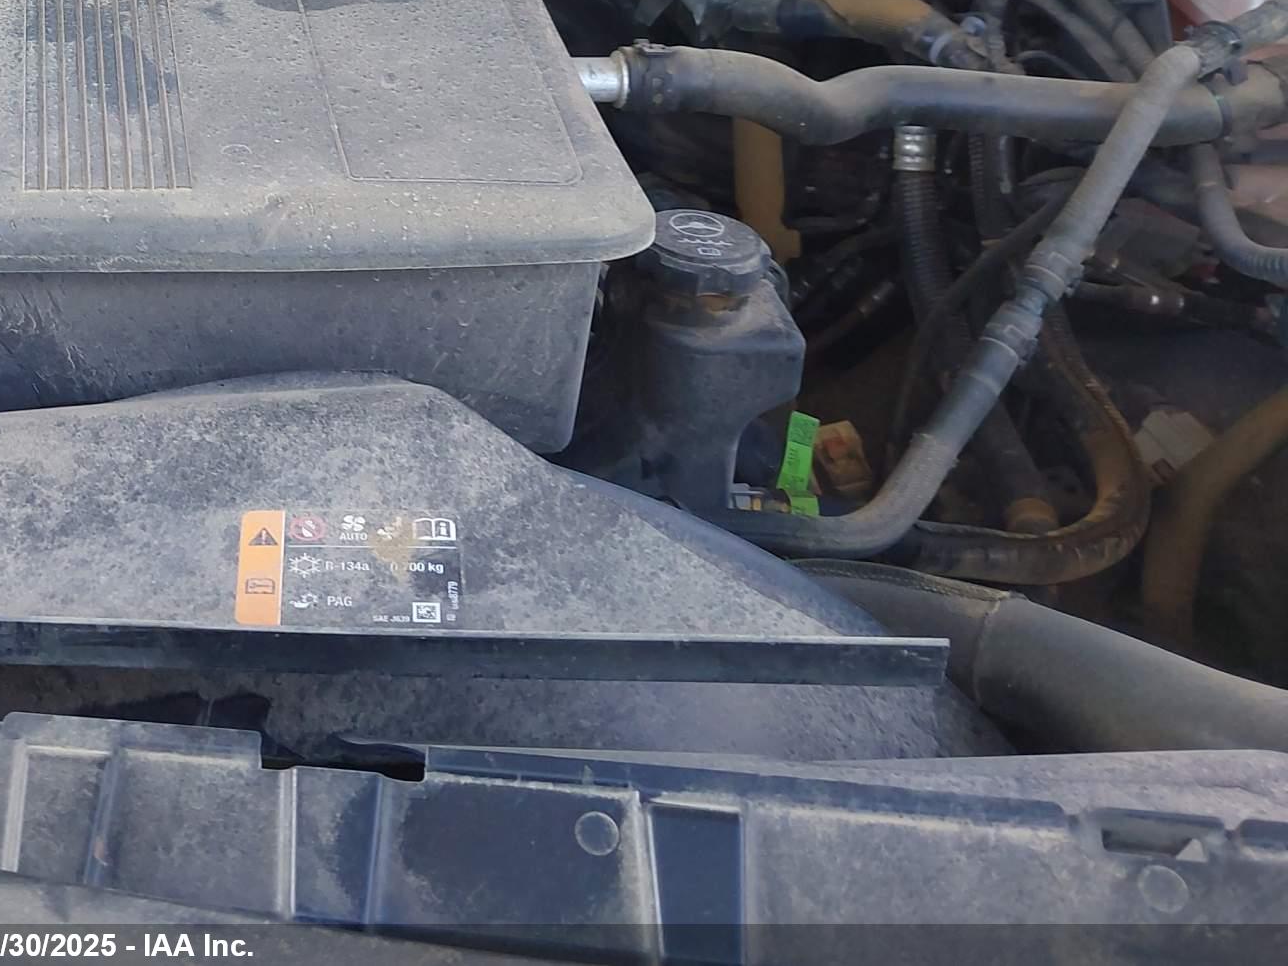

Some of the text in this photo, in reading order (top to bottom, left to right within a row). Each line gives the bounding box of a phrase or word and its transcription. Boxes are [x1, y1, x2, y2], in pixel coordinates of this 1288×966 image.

[339, 532, 368, 541] AUTO
[325, 560, 370, 571] R-134a
[428, 561, 445, 574] kg
[327, 595, 353, 607] PAG
